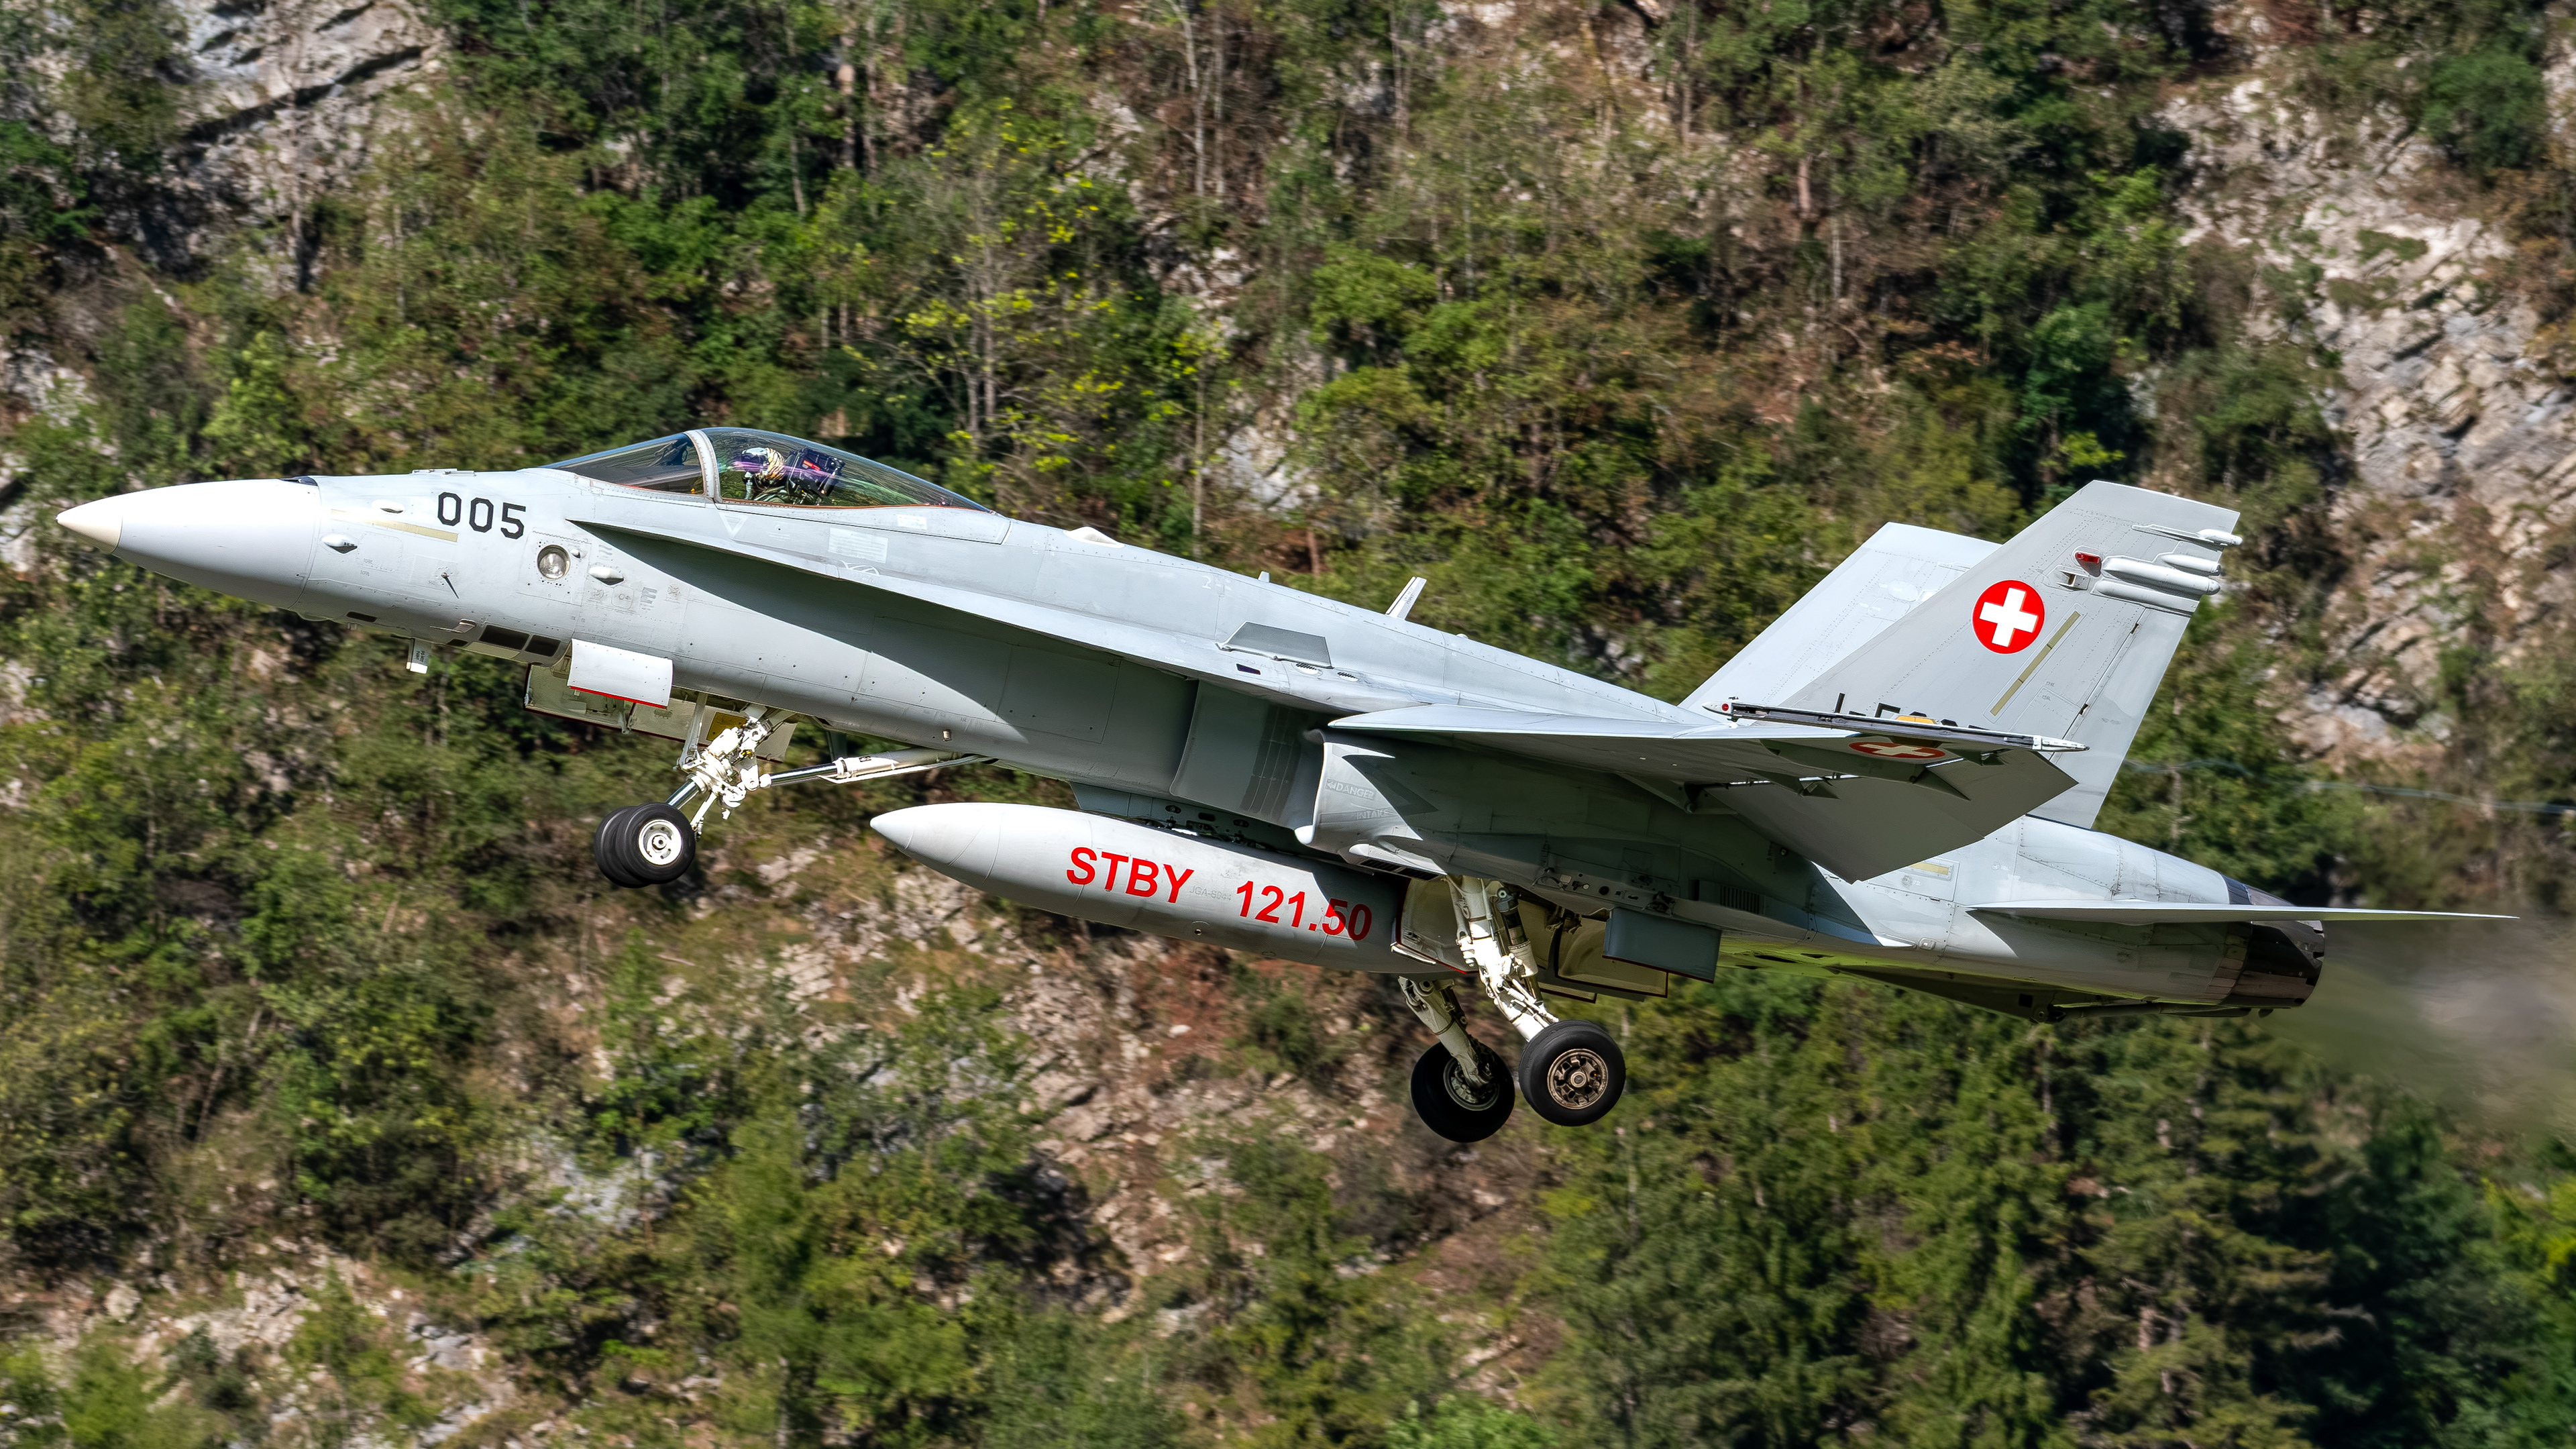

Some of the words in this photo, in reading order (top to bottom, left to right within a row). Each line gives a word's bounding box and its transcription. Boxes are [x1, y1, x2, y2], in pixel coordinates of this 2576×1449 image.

[437, 492, 527, 539] 005
[1336, 782, 1375, 799] DANGER
[1067, 847, 1195, 904] STBY
[1236, 880, 1372, 941] 121.50
